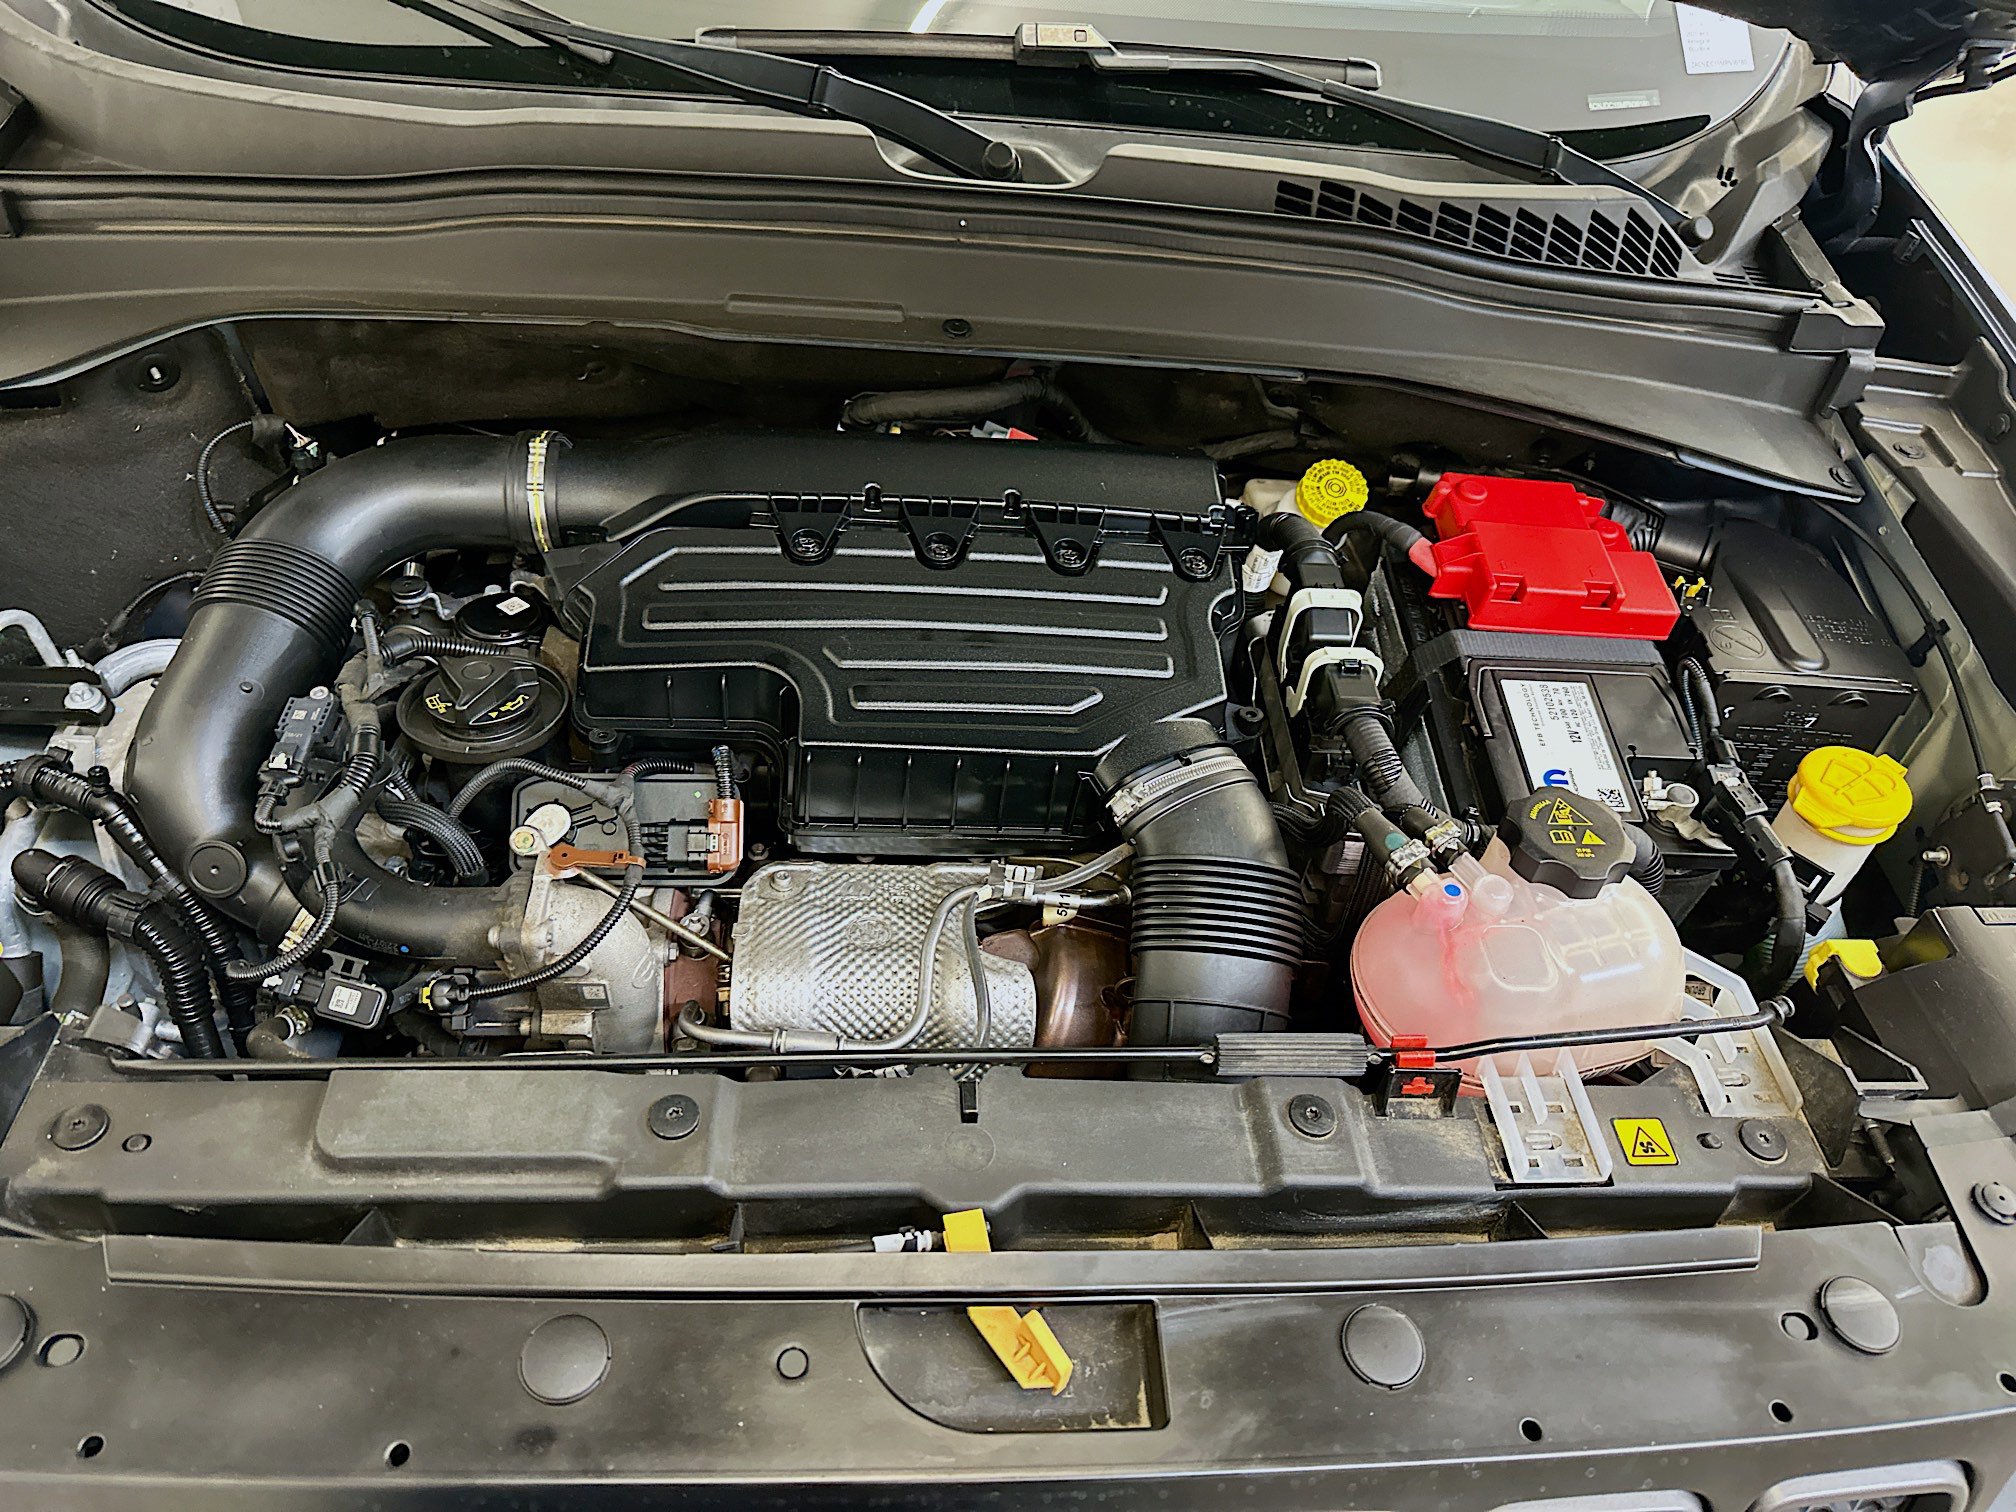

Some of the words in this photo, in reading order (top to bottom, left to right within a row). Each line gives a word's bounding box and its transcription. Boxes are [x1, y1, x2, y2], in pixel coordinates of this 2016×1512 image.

[1552, 687, 1560, 695] 70
[1521, 683, 1540, 730] TECHNOLOGY
[1559, 708, 1569, 719] 700
[1570, 708, 1579, 719] 120
[1537, 732, 1546, 747] EFB
[1567, 730, 1582, 743] 12V
